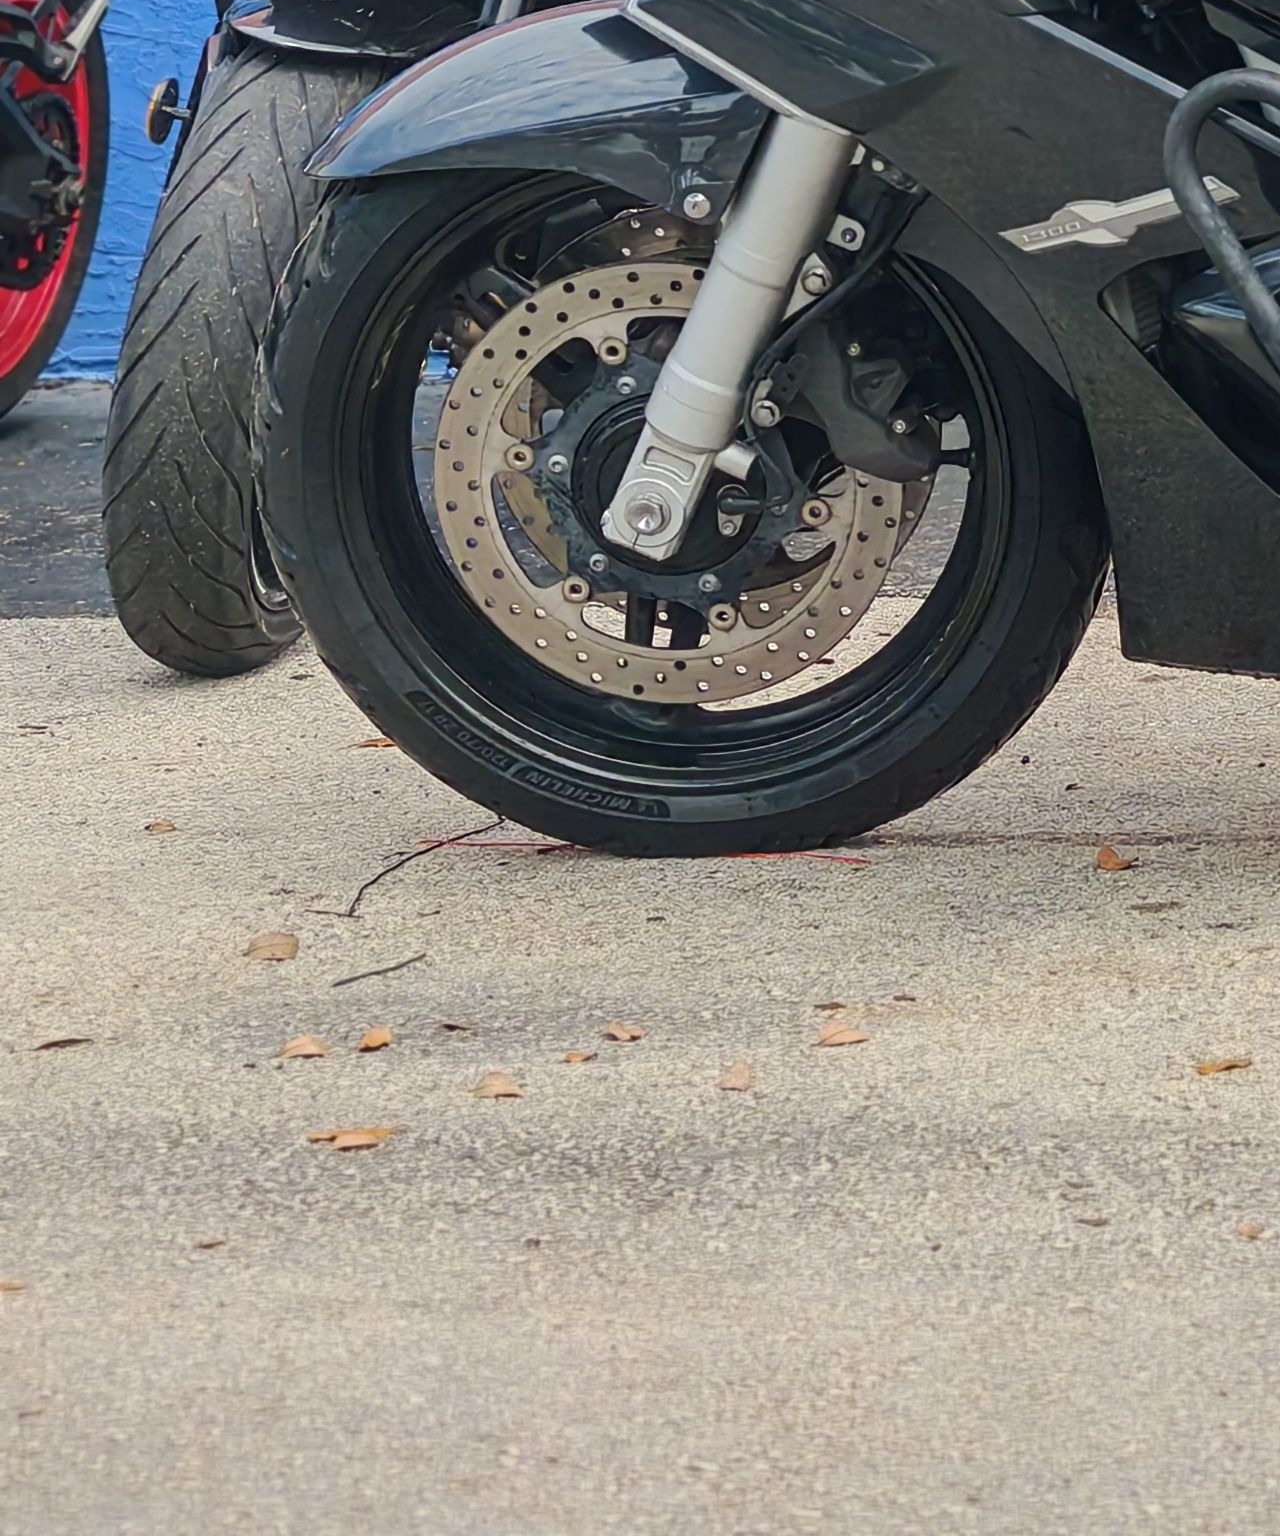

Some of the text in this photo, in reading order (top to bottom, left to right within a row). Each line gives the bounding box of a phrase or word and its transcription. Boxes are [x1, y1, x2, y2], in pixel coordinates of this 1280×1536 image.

[1022, 221, 1081, 242] 1300
[457, 730, 511, 770] 120/70
[525, 769, 632, 810] MICHELIN
